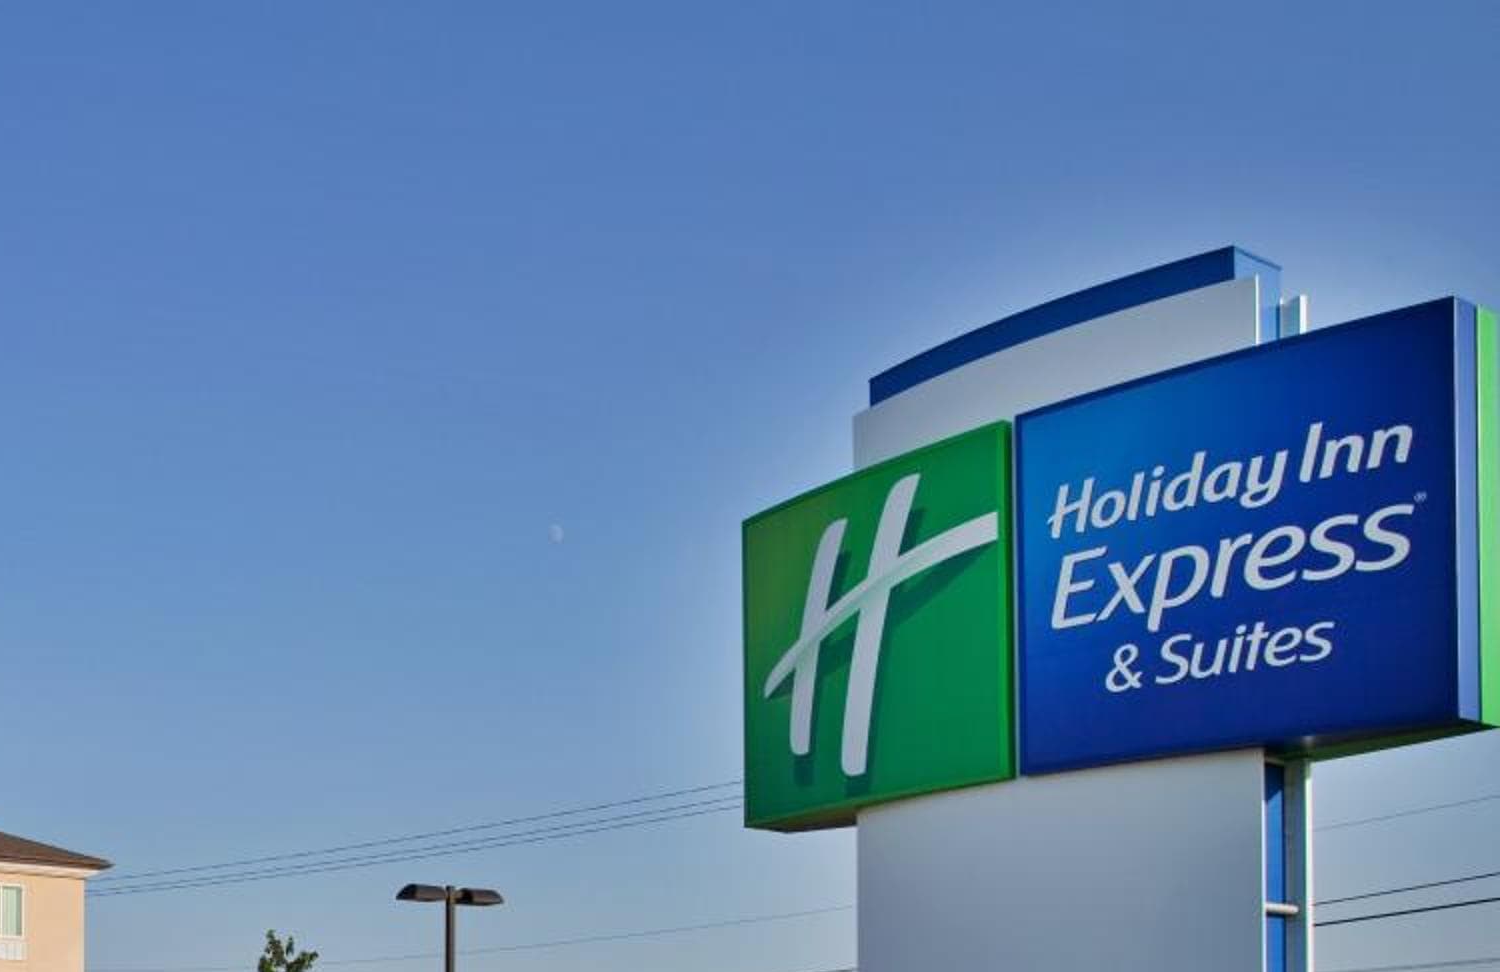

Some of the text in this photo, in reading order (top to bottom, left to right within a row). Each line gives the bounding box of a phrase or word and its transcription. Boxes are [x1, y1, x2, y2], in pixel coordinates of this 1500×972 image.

[1048, 421, 1414, 540] Holiday Inn
[1050, 503, 1415, 634] Express
[1105, 621, 1336, 693] & Suites
